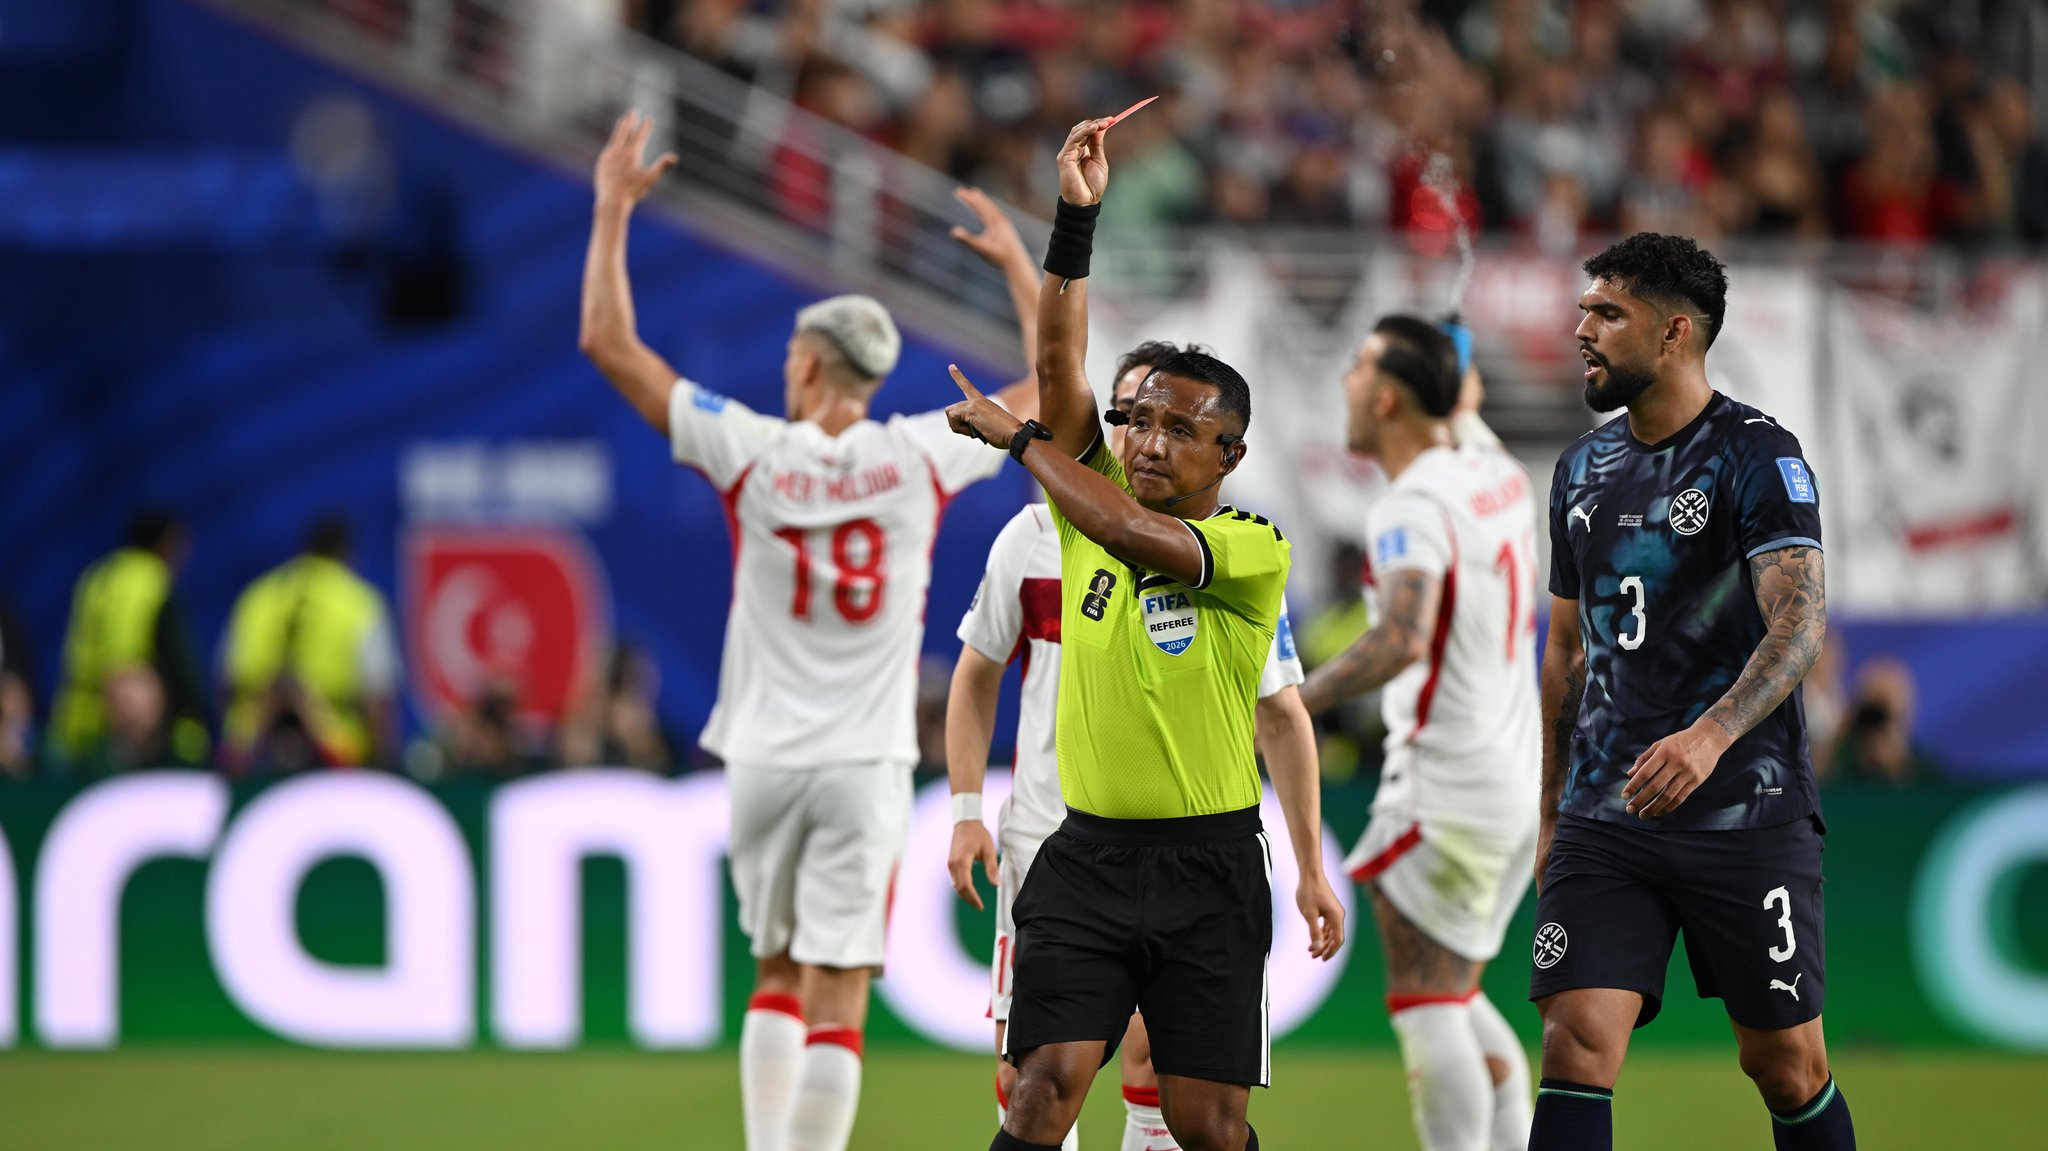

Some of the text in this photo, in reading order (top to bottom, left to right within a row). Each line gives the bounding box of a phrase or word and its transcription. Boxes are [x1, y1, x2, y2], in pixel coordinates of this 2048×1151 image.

[1685, 492, 1699, 501] APF
[771, 517, 886, 625] 18
[1086, 606, 1098, 617] FIFA
[1145, 592, 1191, 614] FIFA
[1618, 576, 1646, 651] 3
[1150, 616, 1194, 633] REFEREE
[1165, 640, 1186, 651] 2026
[1542, 925, 1555, 936] APF
[1763, 885, 1796, 963] 3
